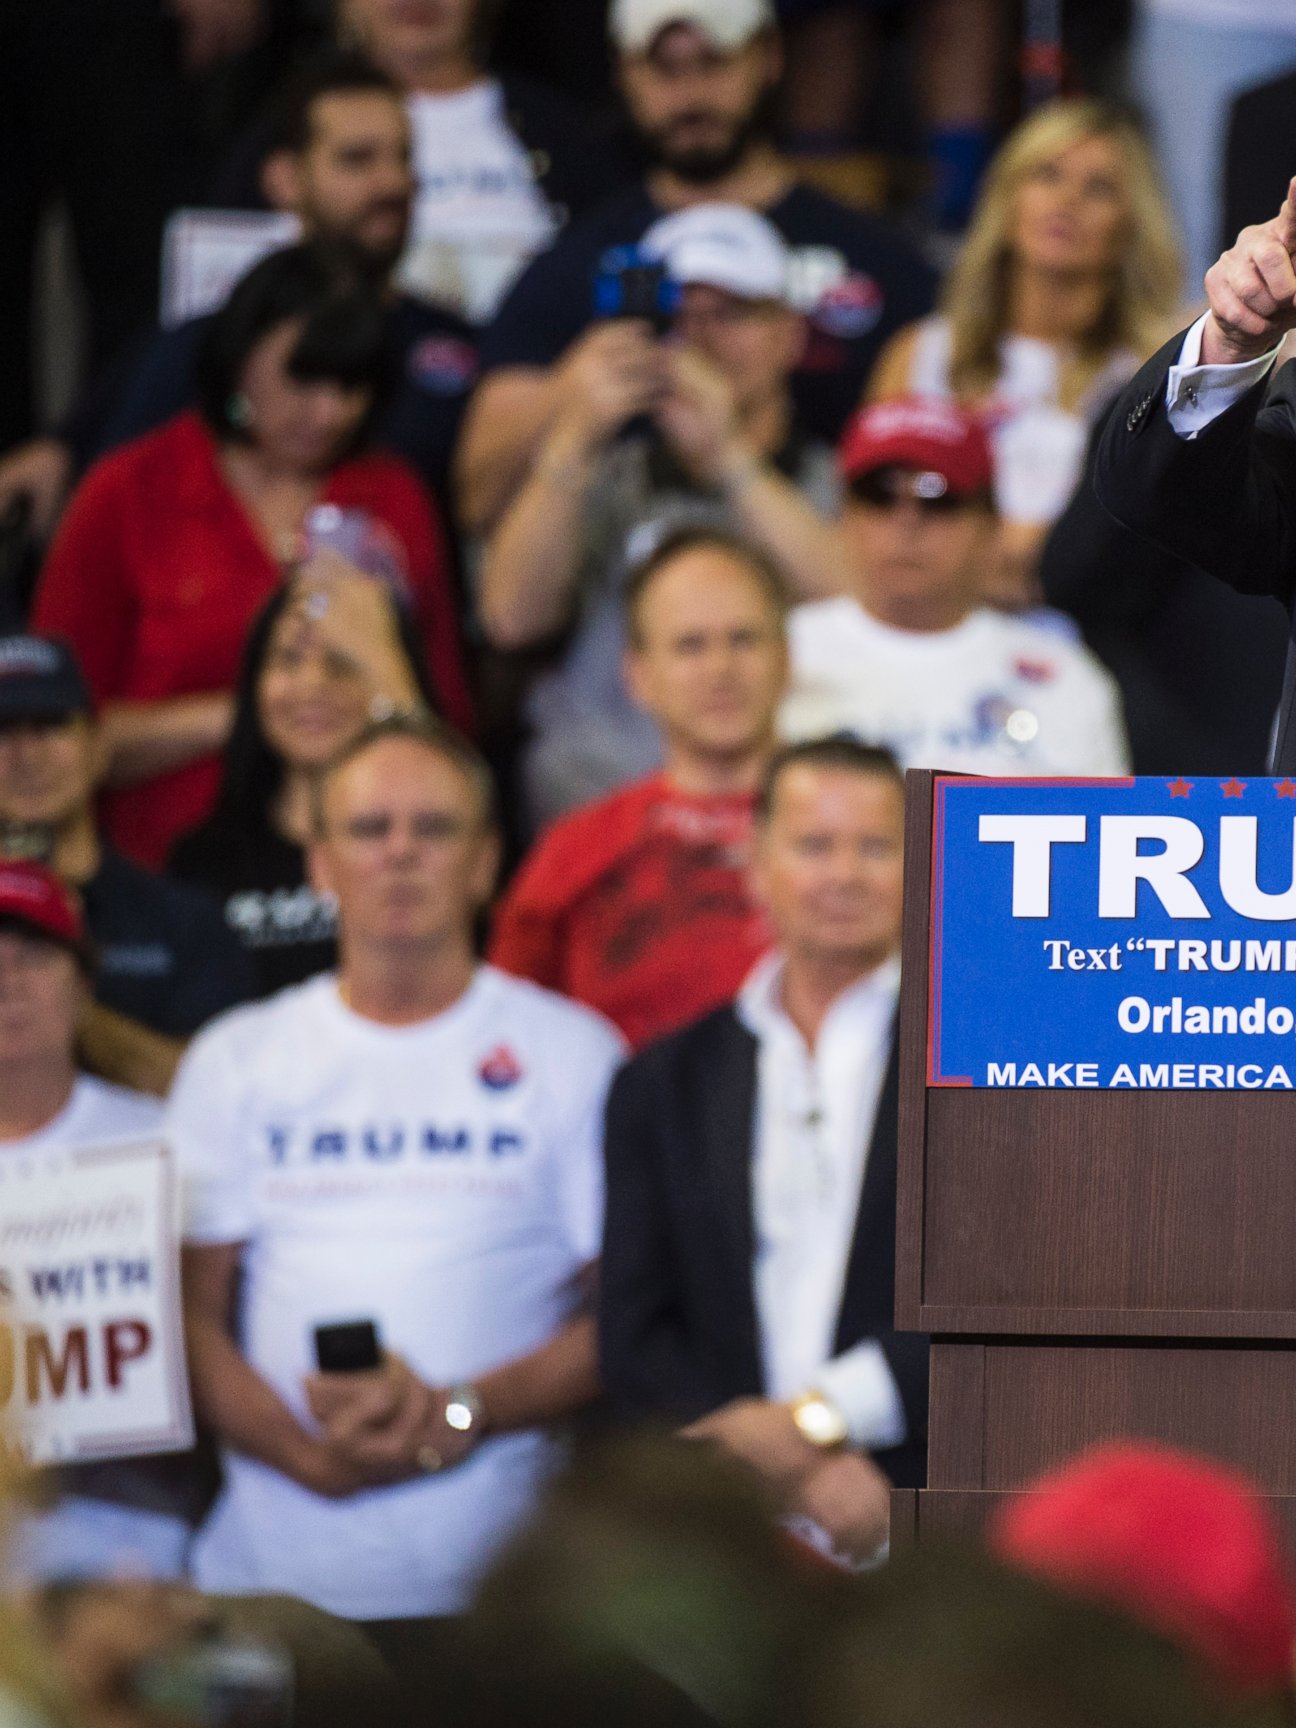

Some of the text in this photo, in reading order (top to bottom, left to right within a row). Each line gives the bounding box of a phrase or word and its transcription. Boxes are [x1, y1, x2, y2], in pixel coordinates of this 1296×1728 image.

[1043, 939, 1122, 971] Text
[986, 1062, 1100, 1087] MAKE
[1109, 1063, 1294, 1089] AMERICA
